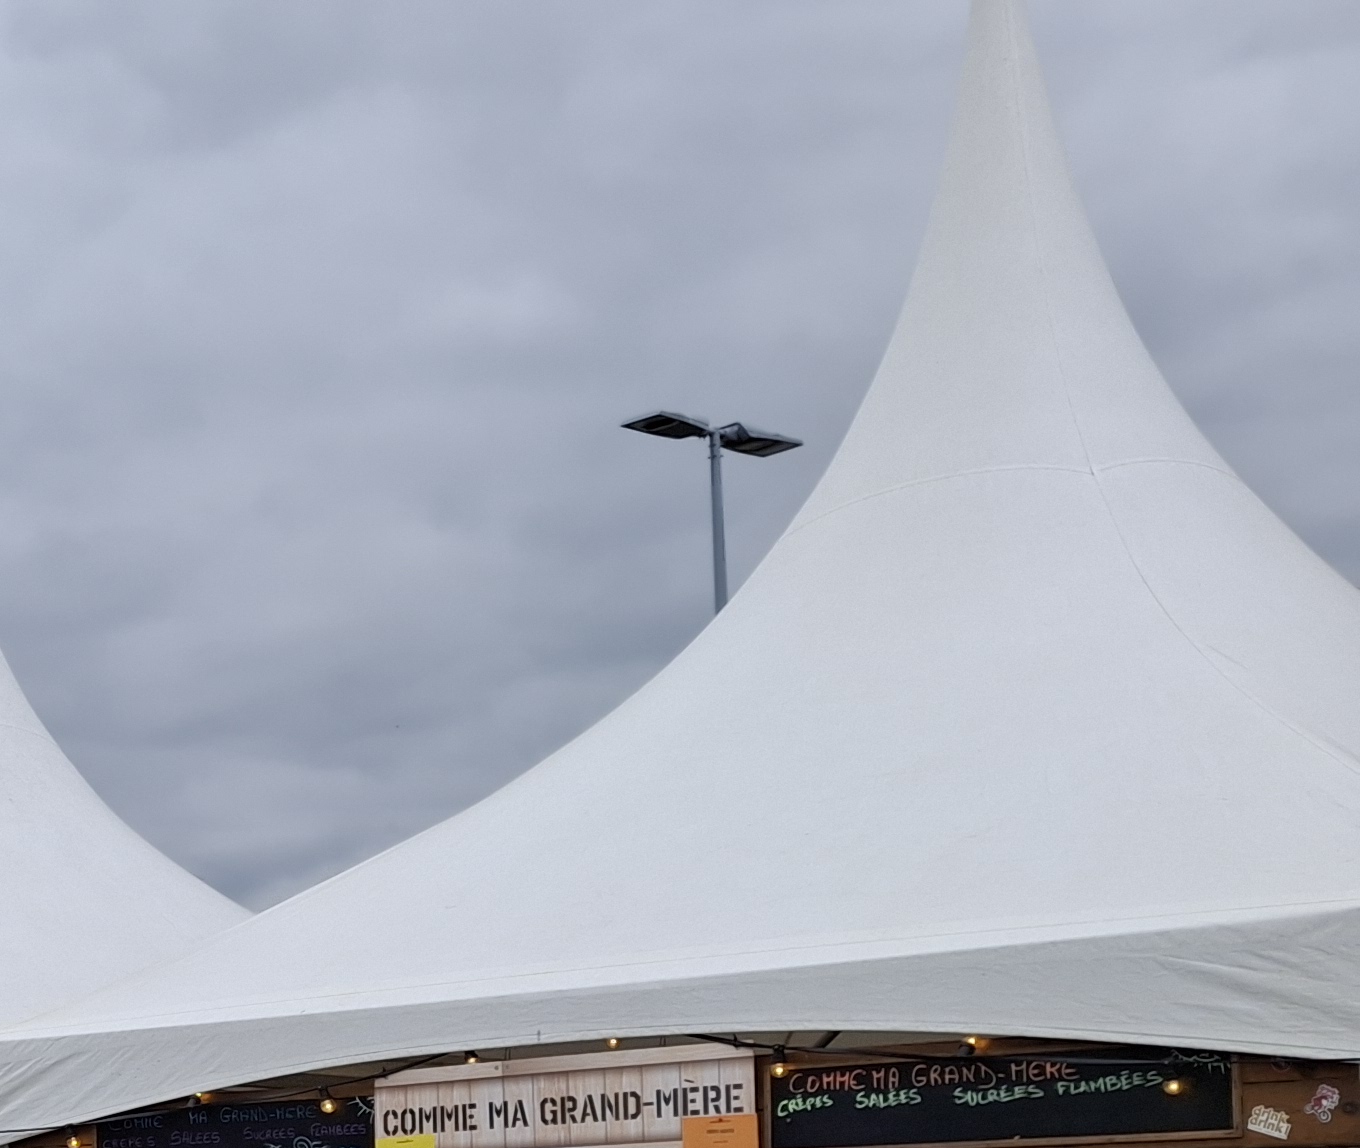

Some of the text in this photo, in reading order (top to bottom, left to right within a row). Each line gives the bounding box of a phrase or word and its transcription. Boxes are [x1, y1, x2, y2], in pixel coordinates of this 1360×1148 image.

[789, 1069, 866, 1093] COMME
[873, 1067, 900, 1089] MA
[383, 1078, 745, 1136] COMME MA GRAND-MÈRE
